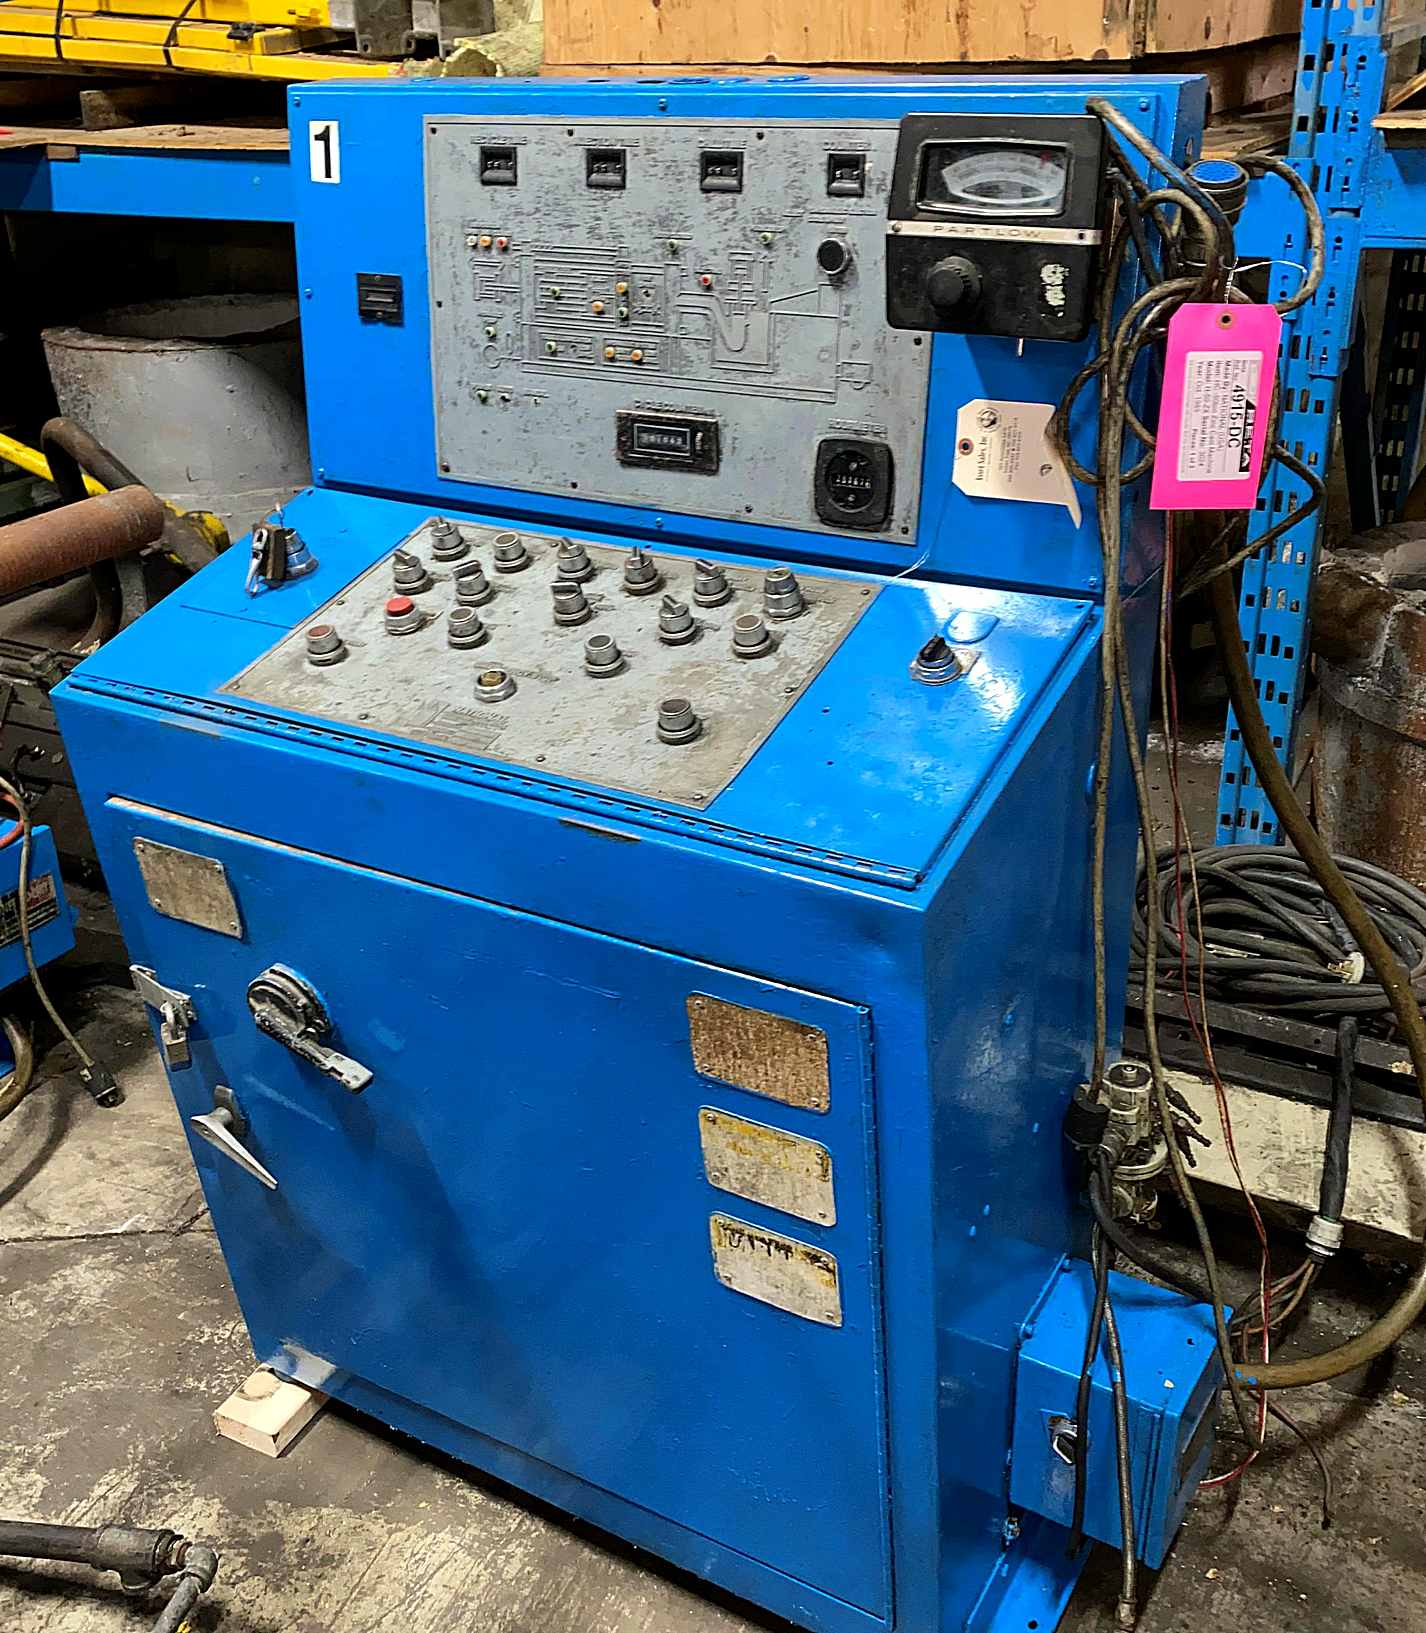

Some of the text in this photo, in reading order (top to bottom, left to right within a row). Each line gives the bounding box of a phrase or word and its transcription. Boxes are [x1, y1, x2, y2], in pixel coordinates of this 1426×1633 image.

[313, 125, 332, 179] 1
[933, 225, 1041, 238] PARTLOW
[1228, 385, 1246, 448] 4915-DC
